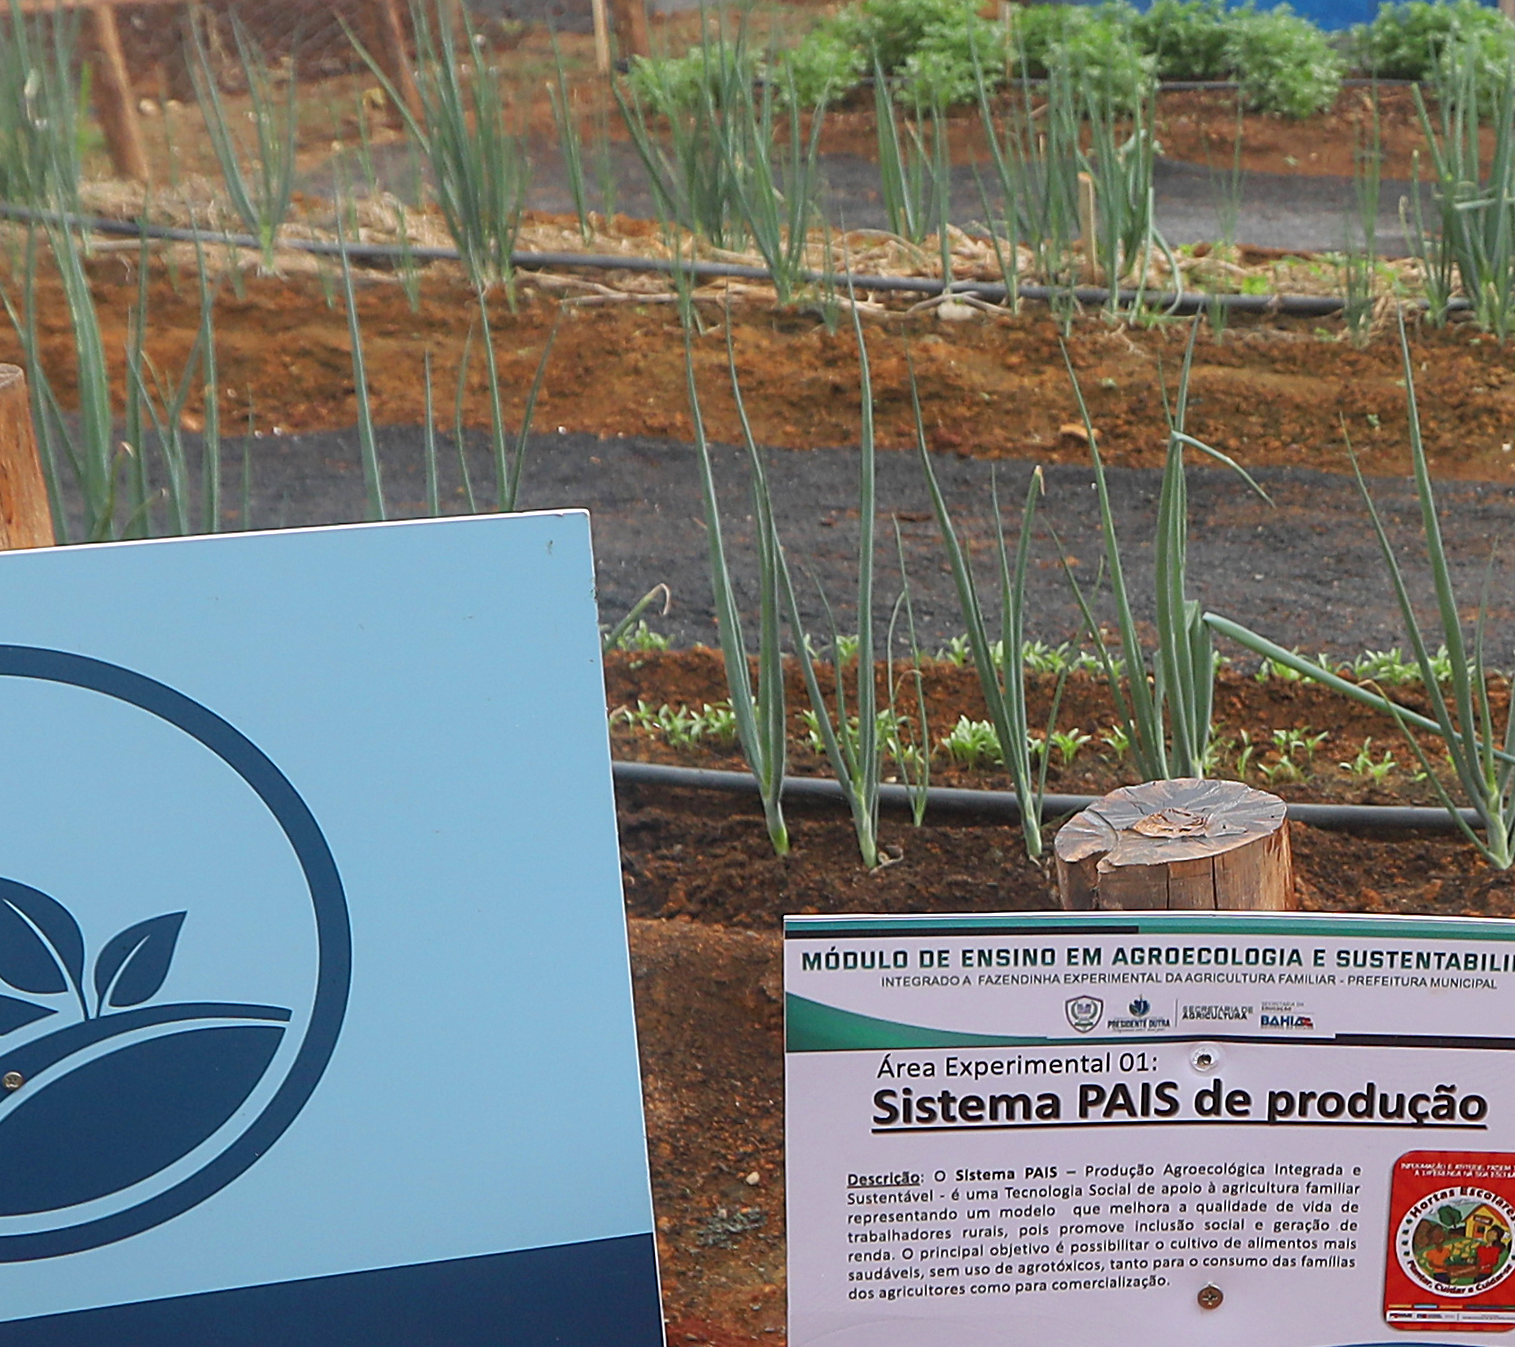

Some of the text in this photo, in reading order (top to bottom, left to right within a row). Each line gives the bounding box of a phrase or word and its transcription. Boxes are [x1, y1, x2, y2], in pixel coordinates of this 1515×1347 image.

[801, 946, 909, 971] MÓDULO
[919, 949, 950, 969] DE
[961, 947, 1056, 968] ENSINO
[1067, 947, 1103, 967] EM
[1112, 947, 1303, 968] AGROECOLOGIA
[1313, 948, 1327, 968] E
[881, 975, 960, 988] INTEGRADO
[962, 975, 972, 987] A
[978, 973, 1060, 986] FAZENDINHA
[1063, 973, 1163, 985] EXPERIMENTAL
[1165, 972, 1183, 984] DA
[1183, 972, 1276, 985] AGRICULTURA
[1278, 974, 1336, 986] FAMILIAR
[1347, 975, 1428, 988] PREFEITURA
[1430, 977, 1498, 990] MUNICIPAL
[1260, 1015, 1305, 1027] BAHIA
[877, 1052, 1158, 1081] Área Experimental 01:
[872, 1078, 1489, 1128] Sistema PAIS de produção
[847, 1171, 924, 1188] Descrição:
[934, 1170, 946, 1182] O
[955, 1168, 1015, 1182] Sistema
[1024, 1166, 1058, 1179] PAIS
[1085, 1163, 1154, 1179] Produção
[1163, 1162, 1265, 1177] Agroecológica
[1275, 1162, 1343, 1177] Integrada
[1352, 1166, 1361, 1176] e
[847, 1190, 933, 1205] Sustentável
[951, 1188, 960, 1201] é
[966, 1190, 998, 1200] uma
[1005, 1184, 1082, 1200] Tecnologia
[1088, 1183, 1131, 1196] Social
[1137, 1182, 1155, 1195] de
[1161, 1182, 1202, 1197] apoio
[1208, 1182, 1216, 1194] à
[1222, 1182, 1300, 1196] agricultura
[1306, 1182, 1361, 1195] familiar
[1409, 1187, 1456, 1219] Hortas
[847, 1200, 1359, 1226] representando um modelo que melhora a qualidade de vida de
[848, 1218, 1358, 1244] trabalhadores rurais, pois promove inclusão social e geração de
[848, 1236, 1357, 1263] renda. O principal objetivo é possibilitar o cultivo de alimentos mais
[848, 1254, 1356, 1282] saudáveis, sem uso de agrotóxicos, tanto para o consumo das famílias
[848, 1274, 1171, 1301] dos agricultores como para comercialização.
